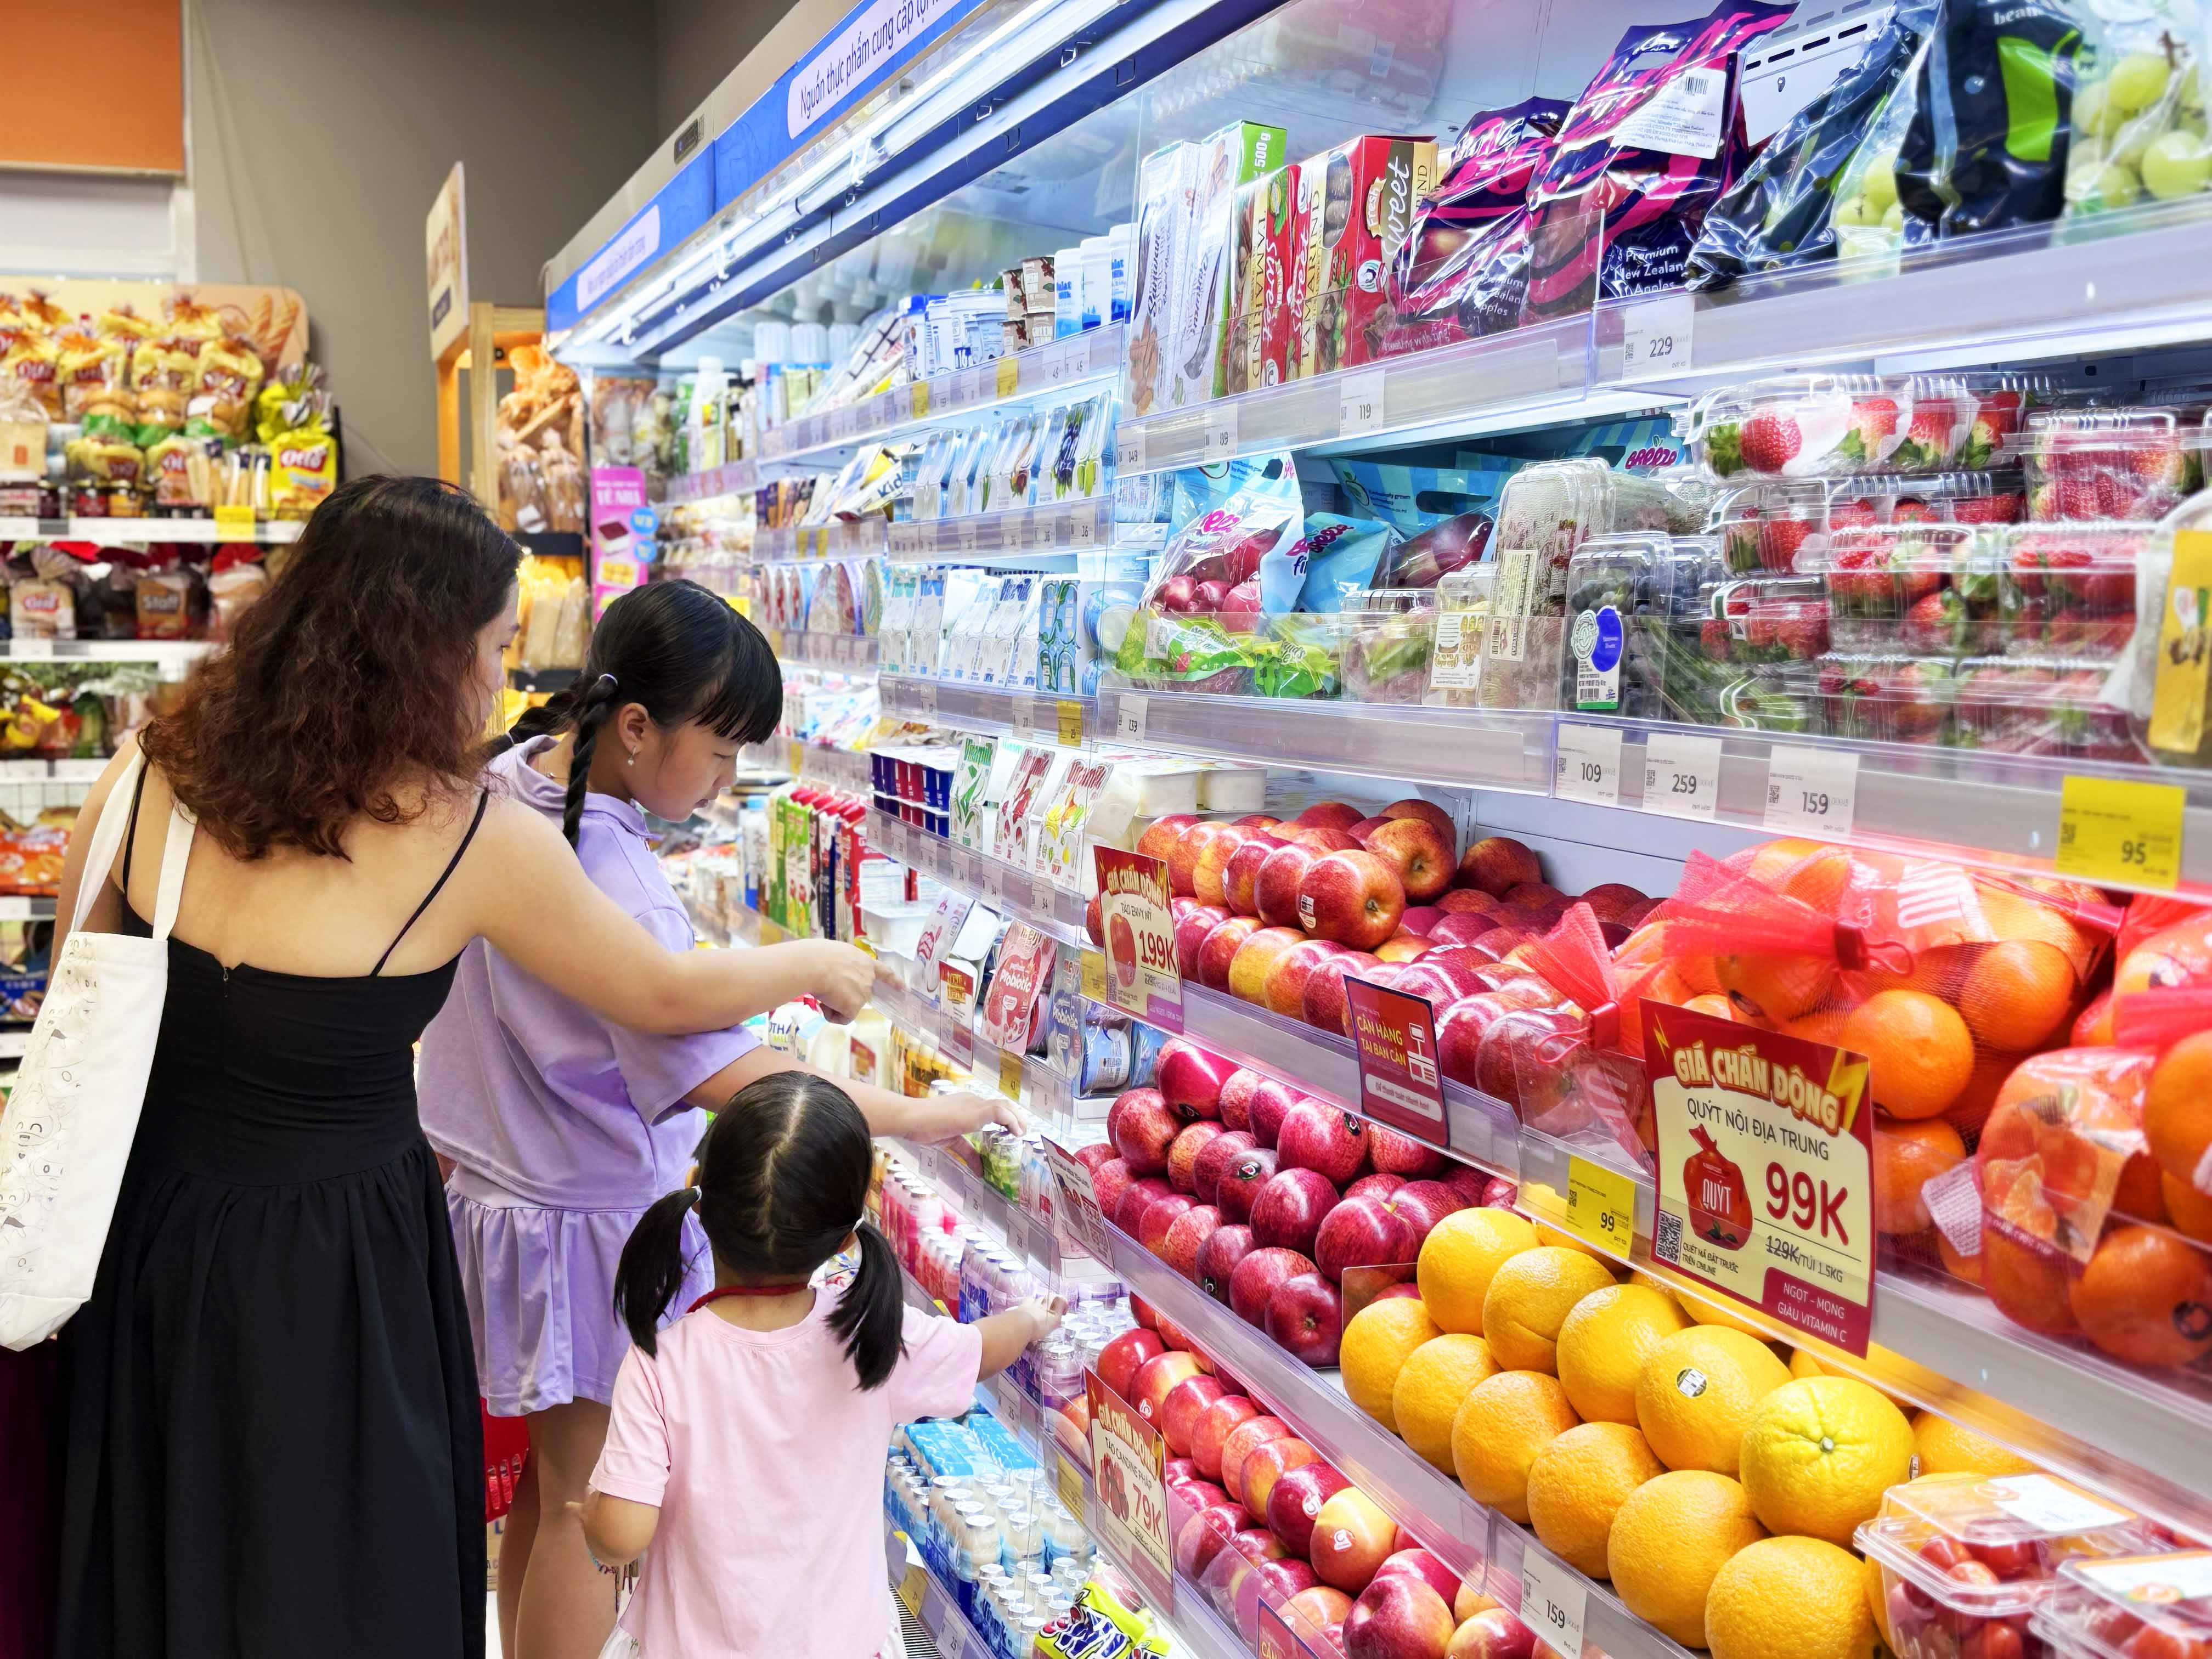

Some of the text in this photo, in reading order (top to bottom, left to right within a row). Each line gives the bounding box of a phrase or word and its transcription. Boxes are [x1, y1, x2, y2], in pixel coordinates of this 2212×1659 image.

[801, 70, 824, 119] Nguồn
[827, 59, 844, 95] thực
[847, 31, 870, 86] phẩm
[872, 16, 894, 55] cung
[1368, 186, 1380, 227] Fresh
[1626, 246, 1678, 263] Premium
[1644, 261, 1685, 276] Zealan
[1650, 336, 1673, 358] 229
[1359, 403, 1372, 420] 119
[1581, 763, 1601, 783] 109
[1672, 774, 1697, 794] 259
[1802, 791, 1829, 815] 159
[2121, 840, 2147, 865] 95
[1139, 930, 1177, 974] 199K
[1376, 1022, 1403, 1046] HÀNG
[1673, 1040, 1714, 1088] GIÁ
[1771, 1063, 1840, 1137] ĐỘNG
[1688, 1098, 1829, 1161] QUÝT NỘI ĐỊA TRUNG
[1703, 1176, 1732, 1215] QUÝT
[1766, 1161, 1849, 1246] 99K
[1600, 1212, 1615, 1232] 99
[1783, 1282, 1809, 1304] NGỌT
[1816, 1295, 1845, 1319] MỌNG
[1778, 1300, 1847, 1343] GIÀU VITAMIN C
[1132, 1483, 1164, 1546] 79K
[1547, 1599, 1565, 1629] 159
